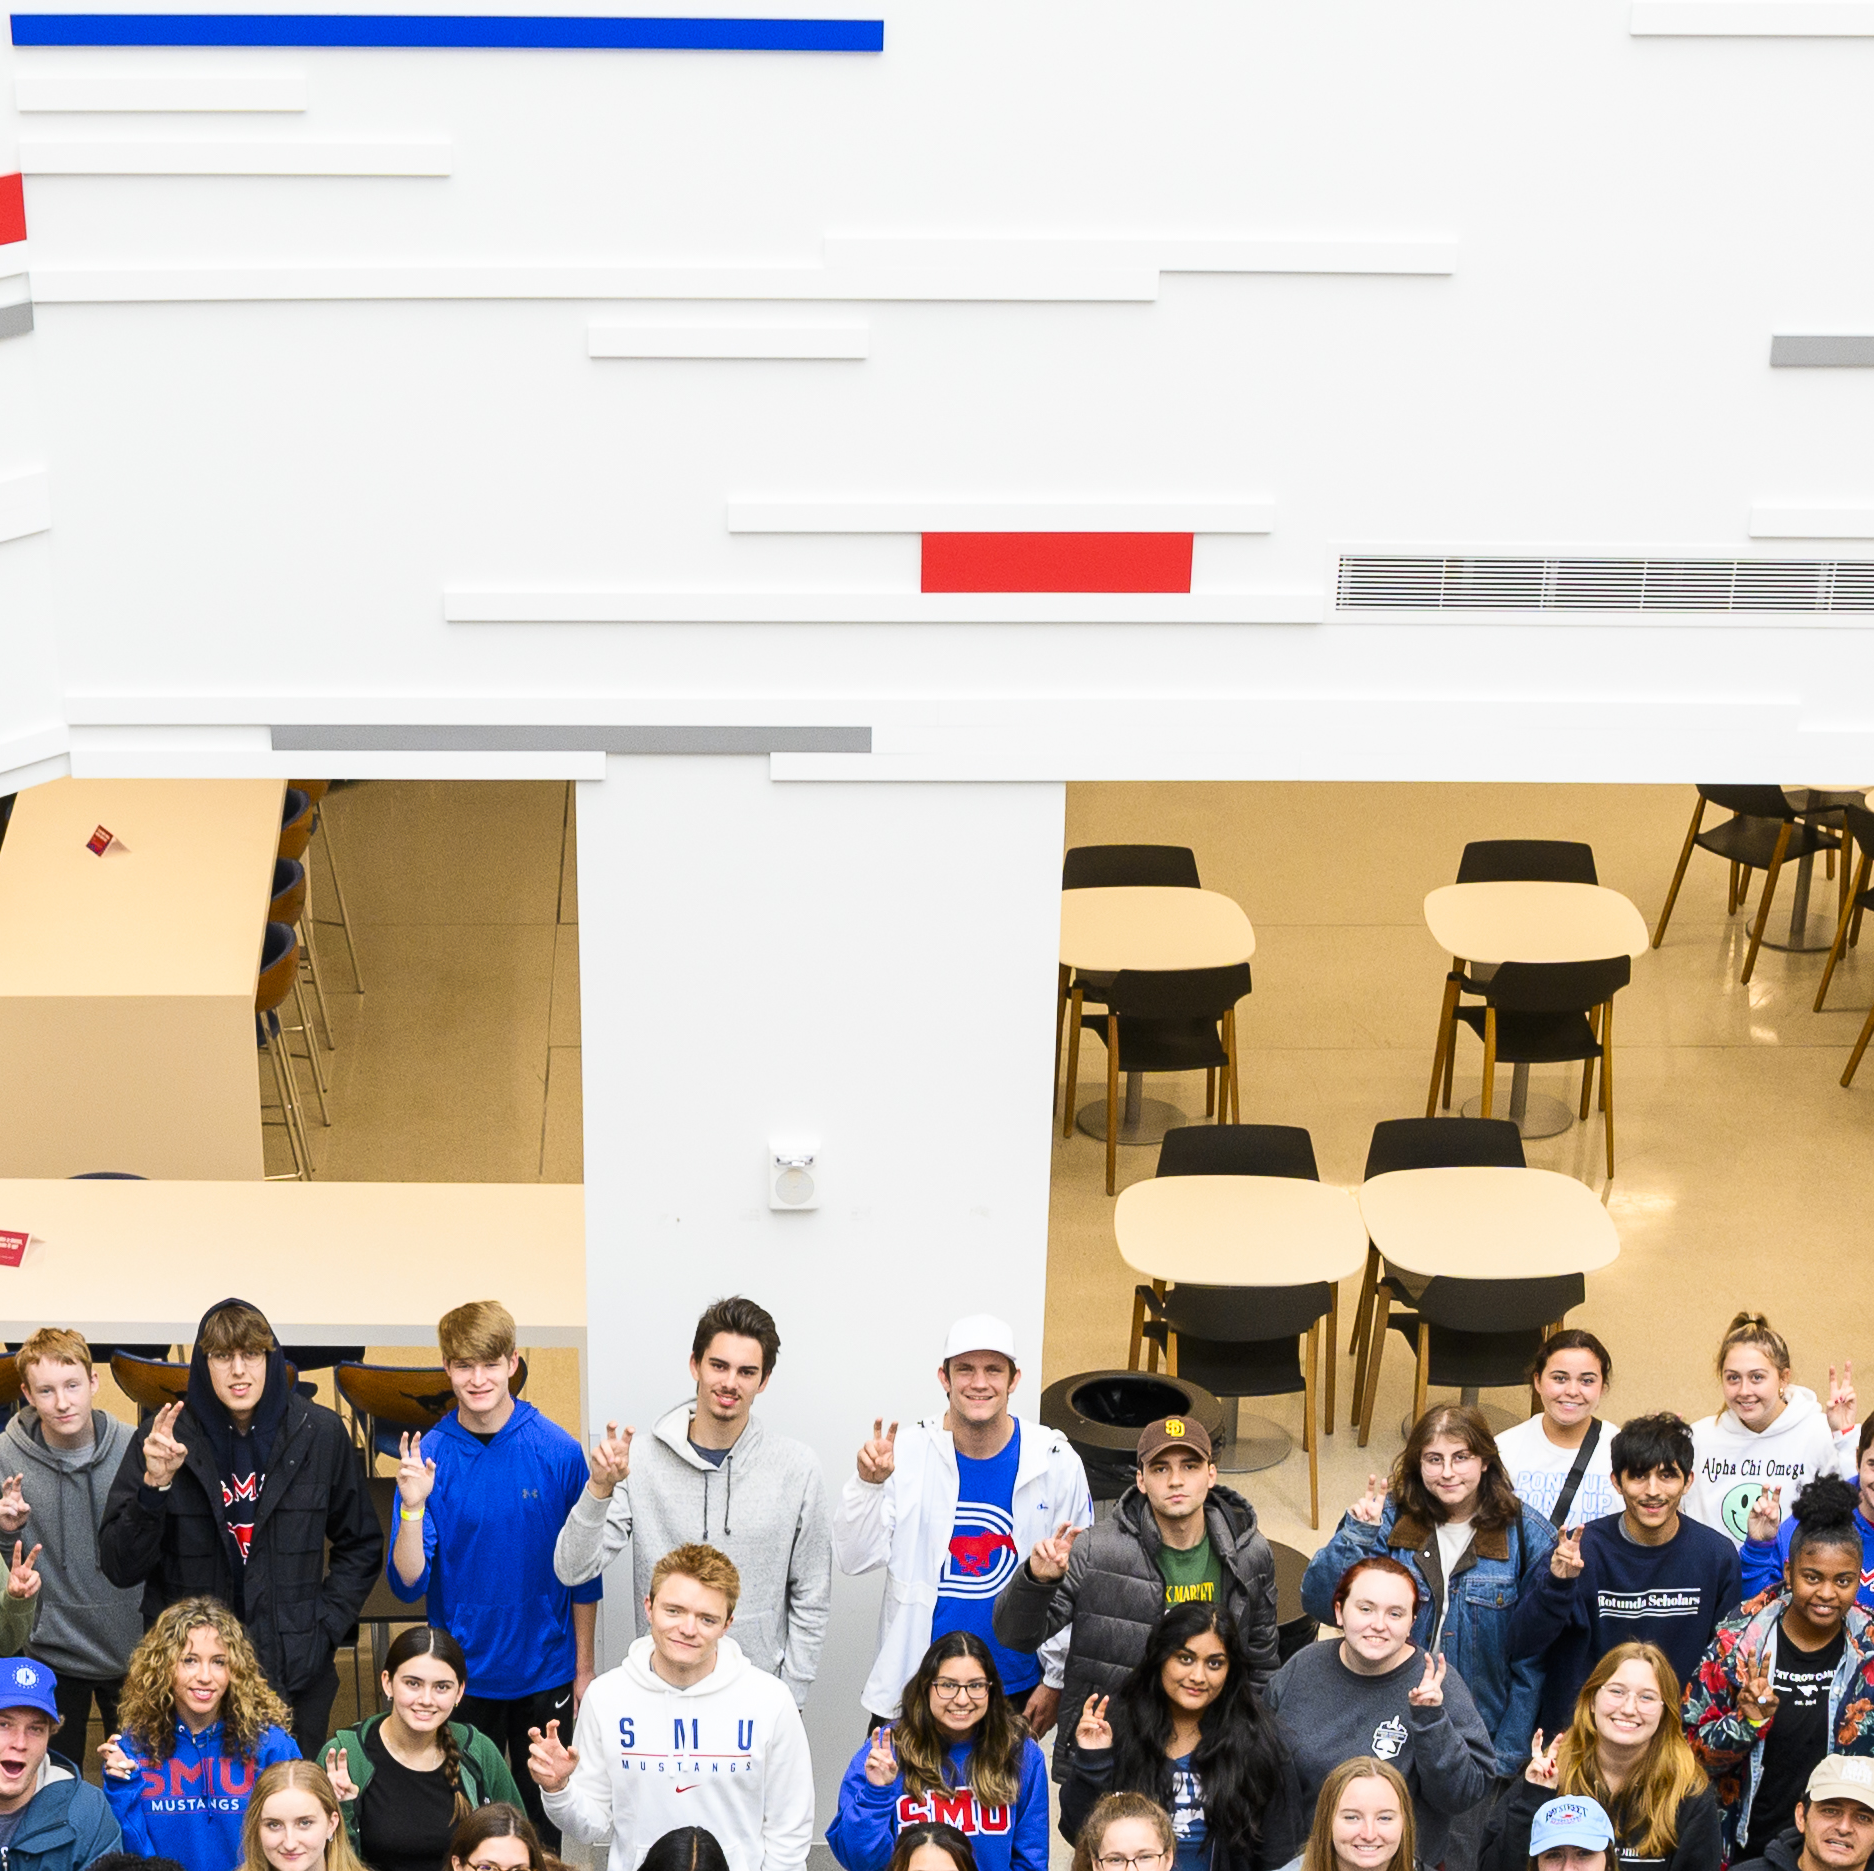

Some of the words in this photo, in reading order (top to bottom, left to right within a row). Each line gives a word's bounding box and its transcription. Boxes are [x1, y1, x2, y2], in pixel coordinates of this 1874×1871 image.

[1702, 1457, 1736, 1483] Alpha
[1741, 1459, 1761, 1476] Chi
[1766, 1459, 1805, 1480] Omega
[1516, 1471, 1569, 1490] PON
[1582, 1473, 1613, 1493] UP
[1648, 1594, 1701, 1607] Scholars
[622, 1759, 752, 1773] MUSTANGS
[140, 1757, 256, 1798] SMU
[151, 1797, 240, 1812] MUSTANGS
[895, 1786, 1012, 1835] SMU
